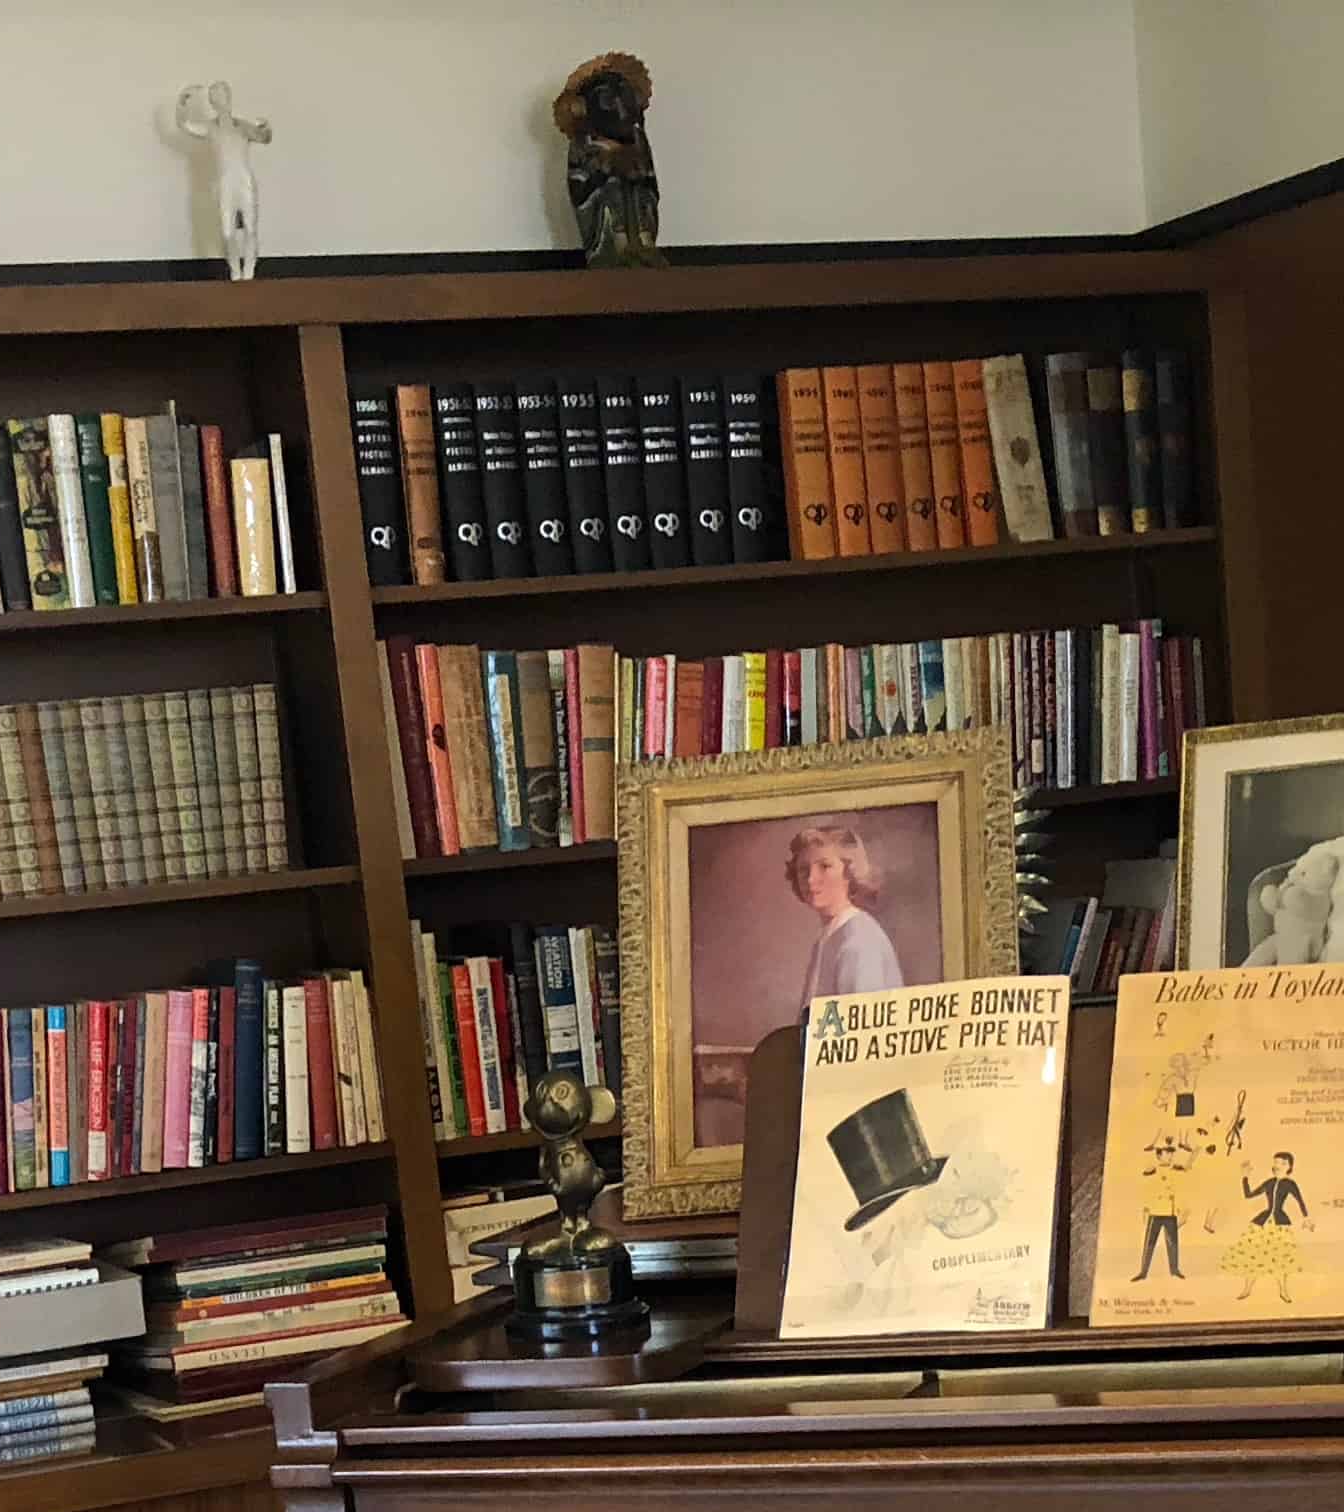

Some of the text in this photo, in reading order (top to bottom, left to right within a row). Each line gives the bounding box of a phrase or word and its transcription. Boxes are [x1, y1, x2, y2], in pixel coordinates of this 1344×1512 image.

[1155, 976, 1226, 1004] Babes
[1234, 972, 1259, 1000] in
[813, 988, 1063, 1039] A BLUE POKE BONNET
[815, 1019, 1061, 1066] AND A STOVE PIPE HAT
[1261, 1038, 1321, 1052] VICTOR
[931, 1244, 1031, 1271] COMPLIMENTARY
